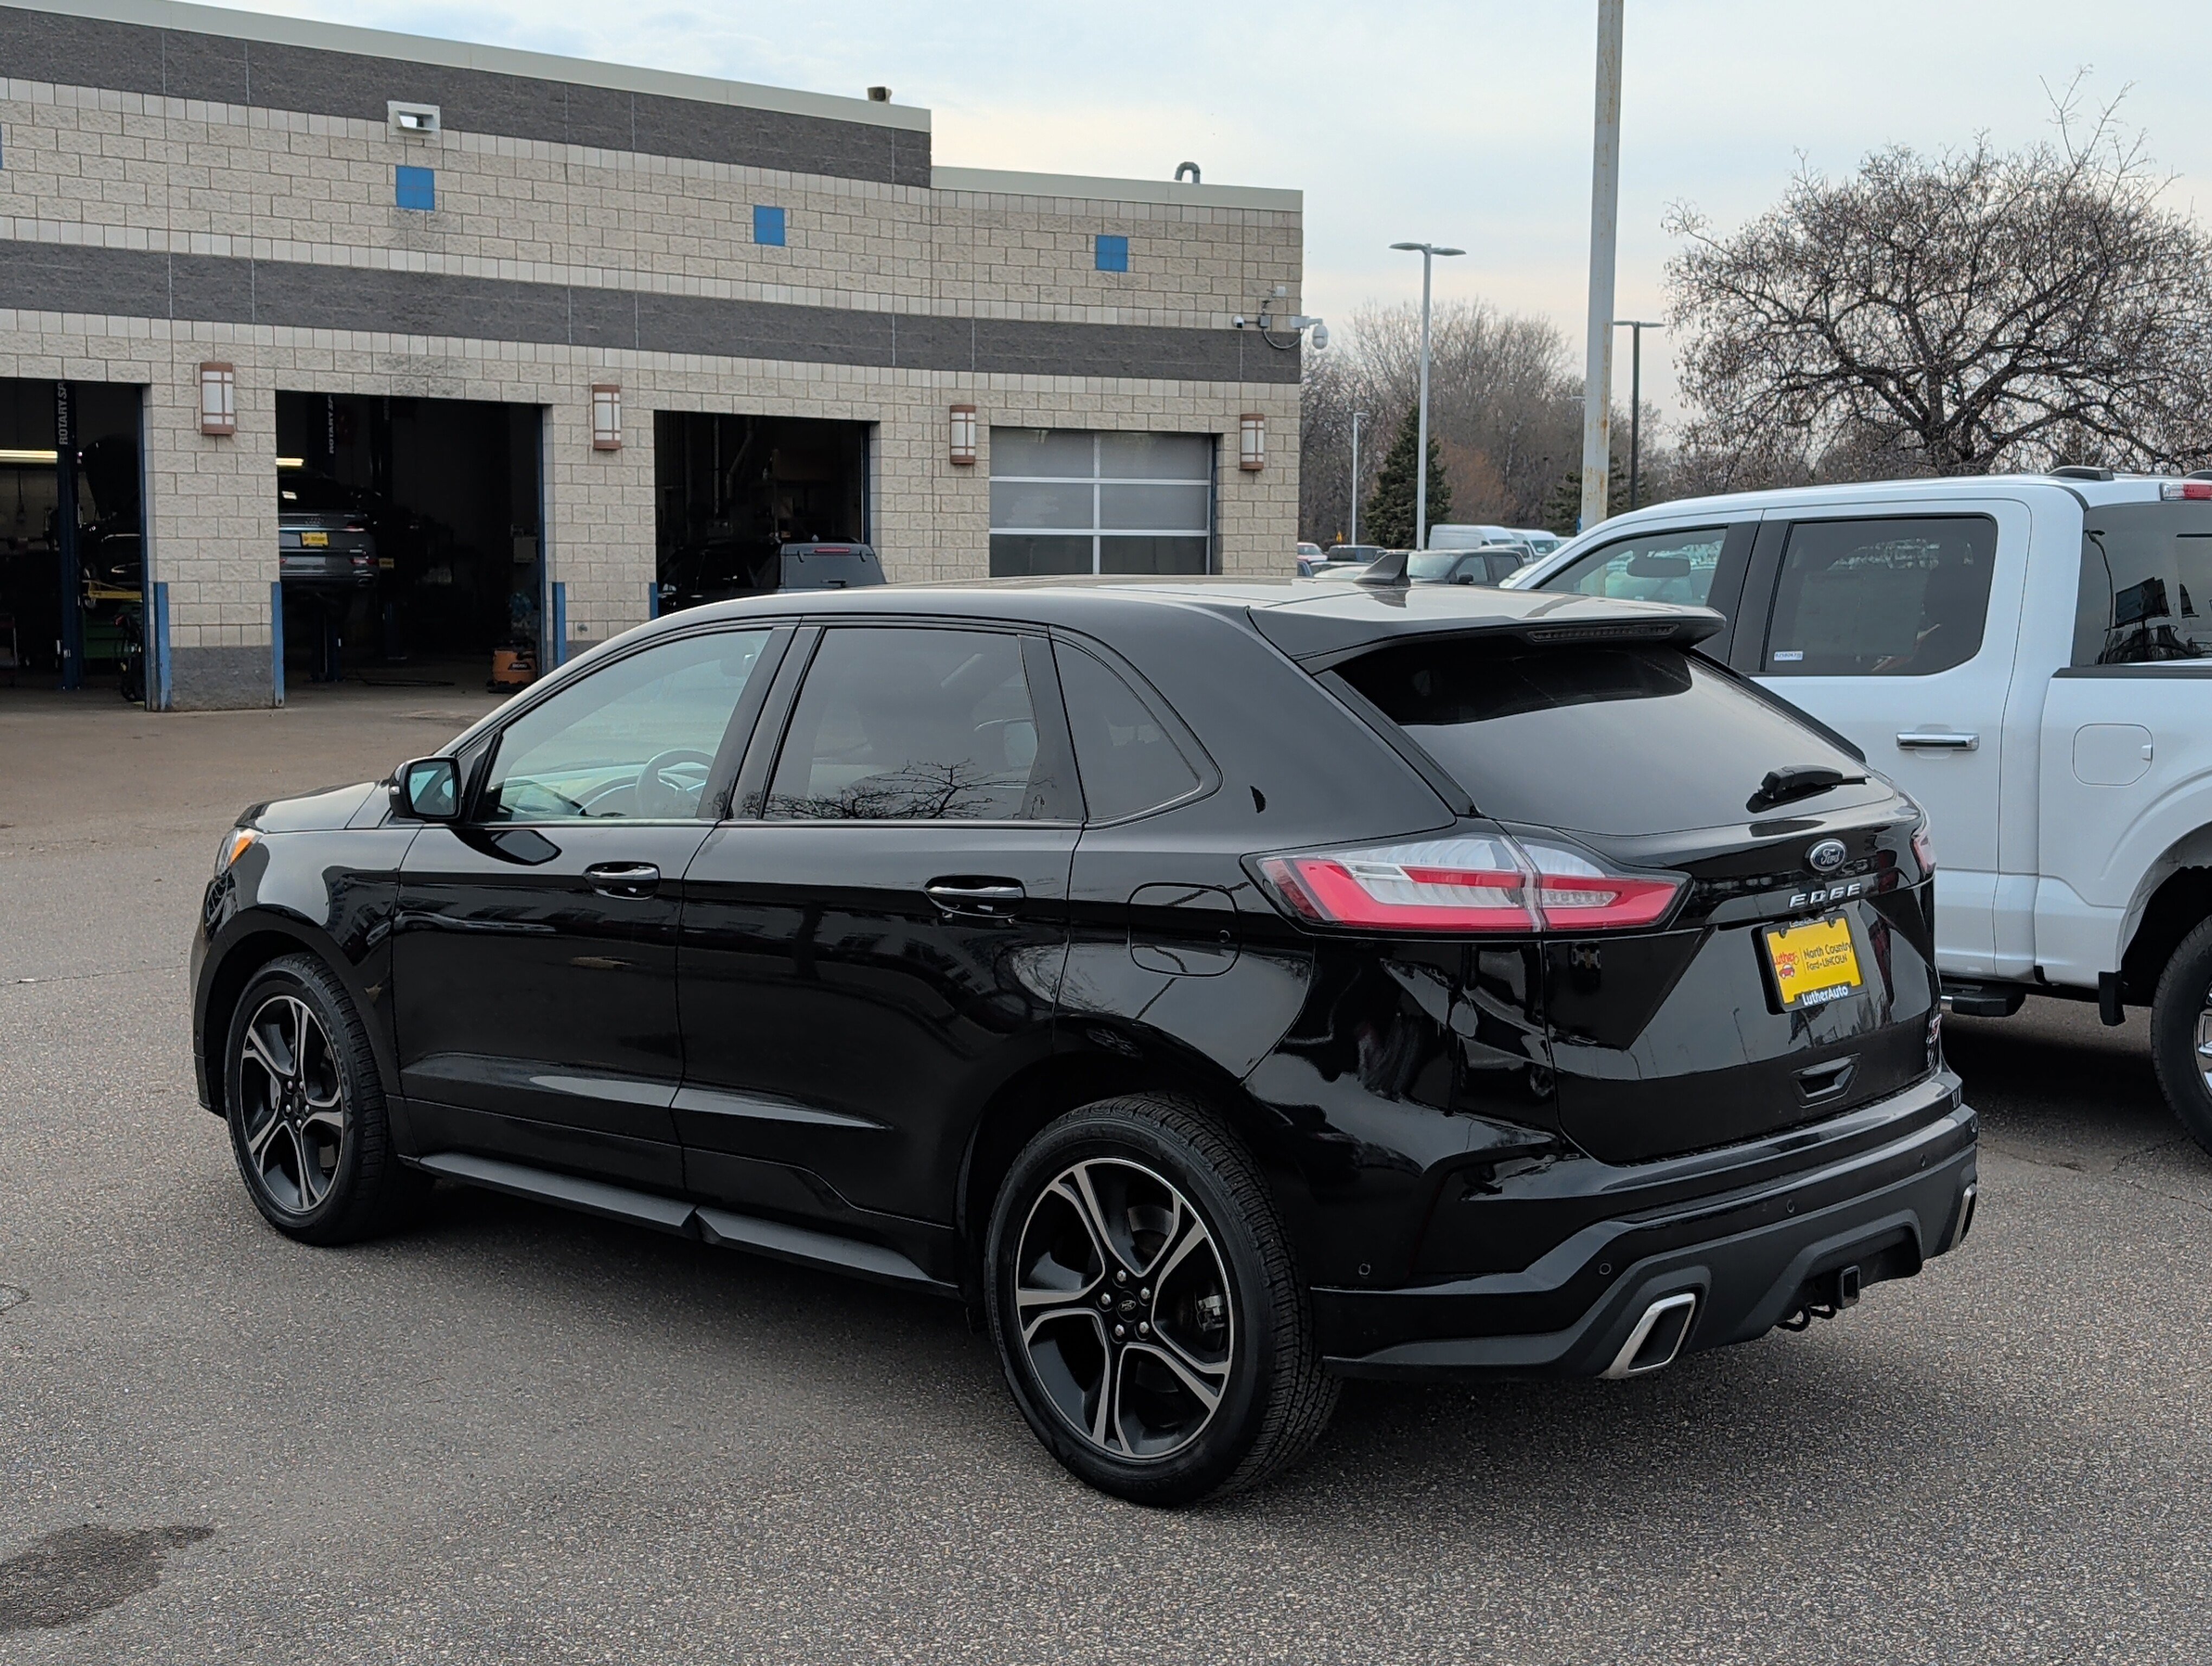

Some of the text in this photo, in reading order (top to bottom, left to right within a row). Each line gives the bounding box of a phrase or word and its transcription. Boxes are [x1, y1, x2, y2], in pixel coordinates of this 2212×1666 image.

[58, 400, 68, 445] ROTARY
[1790, 883, 1861, 908] EDGE
[1803, 941, 1852, 959] North Country
[1802, 985, 1848, 1005] LutherAuto
